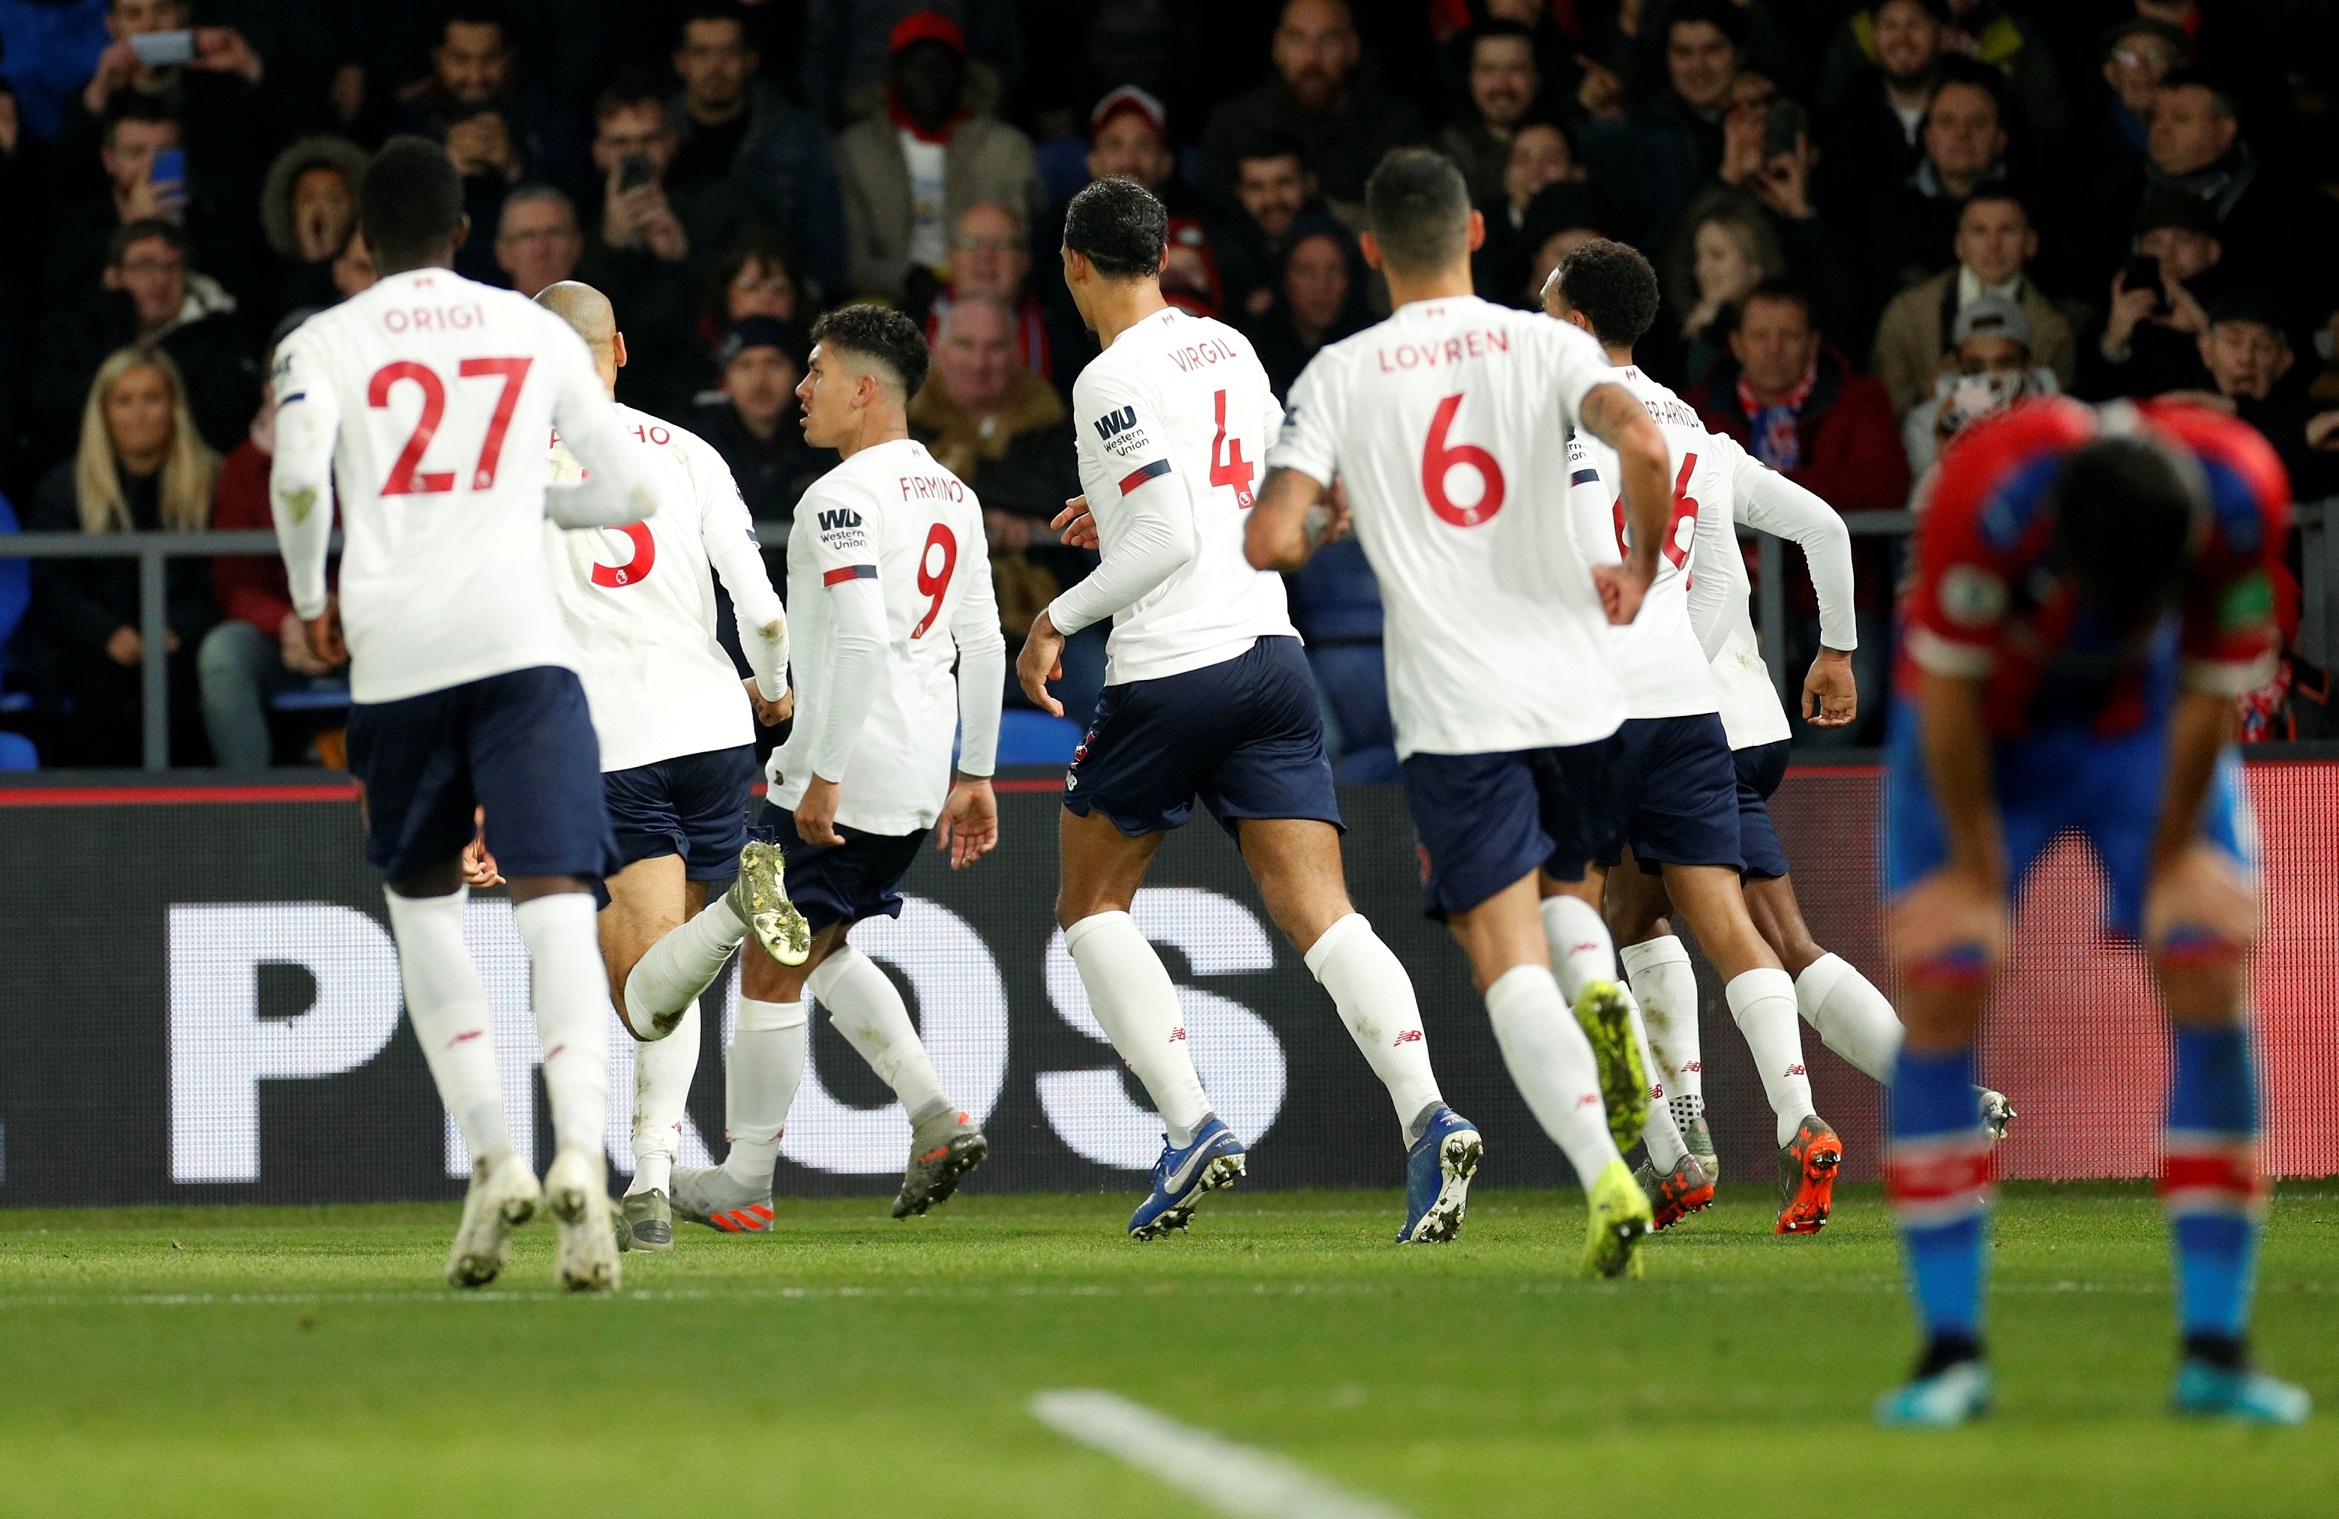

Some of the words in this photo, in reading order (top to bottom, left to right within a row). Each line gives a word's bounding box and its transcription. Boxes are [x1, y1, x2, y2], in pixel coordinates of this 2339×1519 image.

[384, 303, 486, 334] ORIGI
[1167, 337, 1237, 373] VIRGIL
[1377, 327, 1510, 374] LOVREN
[367, 356, 534, 497] 27
[1093, 404, 1137, 441] WU
[1103, 428, 1144, 453] Western
[1116, 438, 1150, 457] Union
[1209, 388, 1257, 510] 4
[1421, 392, 1506, 529] 6
[899, 476, 964, 503] FIRMINO
[817, 508, 862, 531] WU
[820, 530, 865, 543] Western
[833, 538, 867, 550] Union
[909, 522, 958, 640] 9
